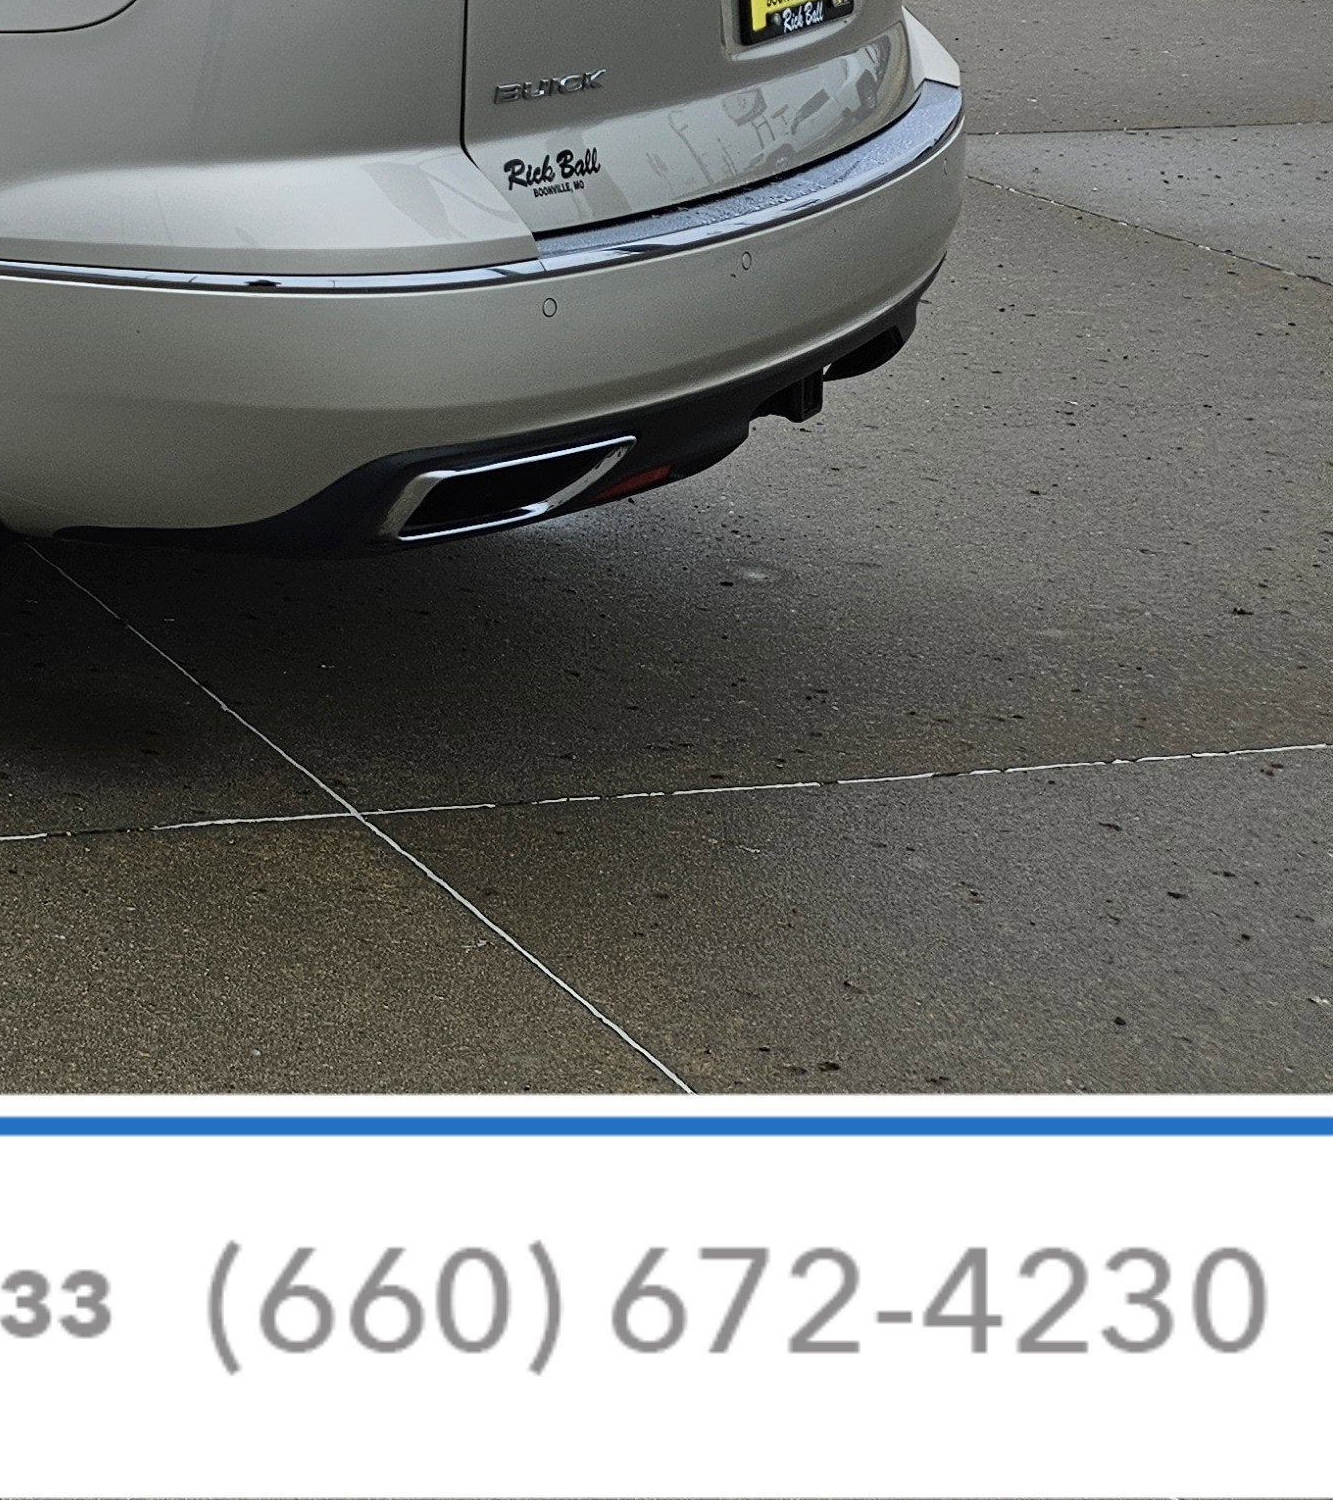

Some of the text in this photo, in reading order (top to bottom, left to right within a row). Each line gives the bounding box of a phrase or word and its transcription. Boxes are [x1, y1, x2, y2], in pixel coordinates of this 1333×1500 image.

[783, 1, 823, 33] Rick Ball
[493, 69, 606, 104] BUICK
[504, 147, 601, 190] Rick Ball
[533, 180, 585, 198] BOONVILLE, MO
